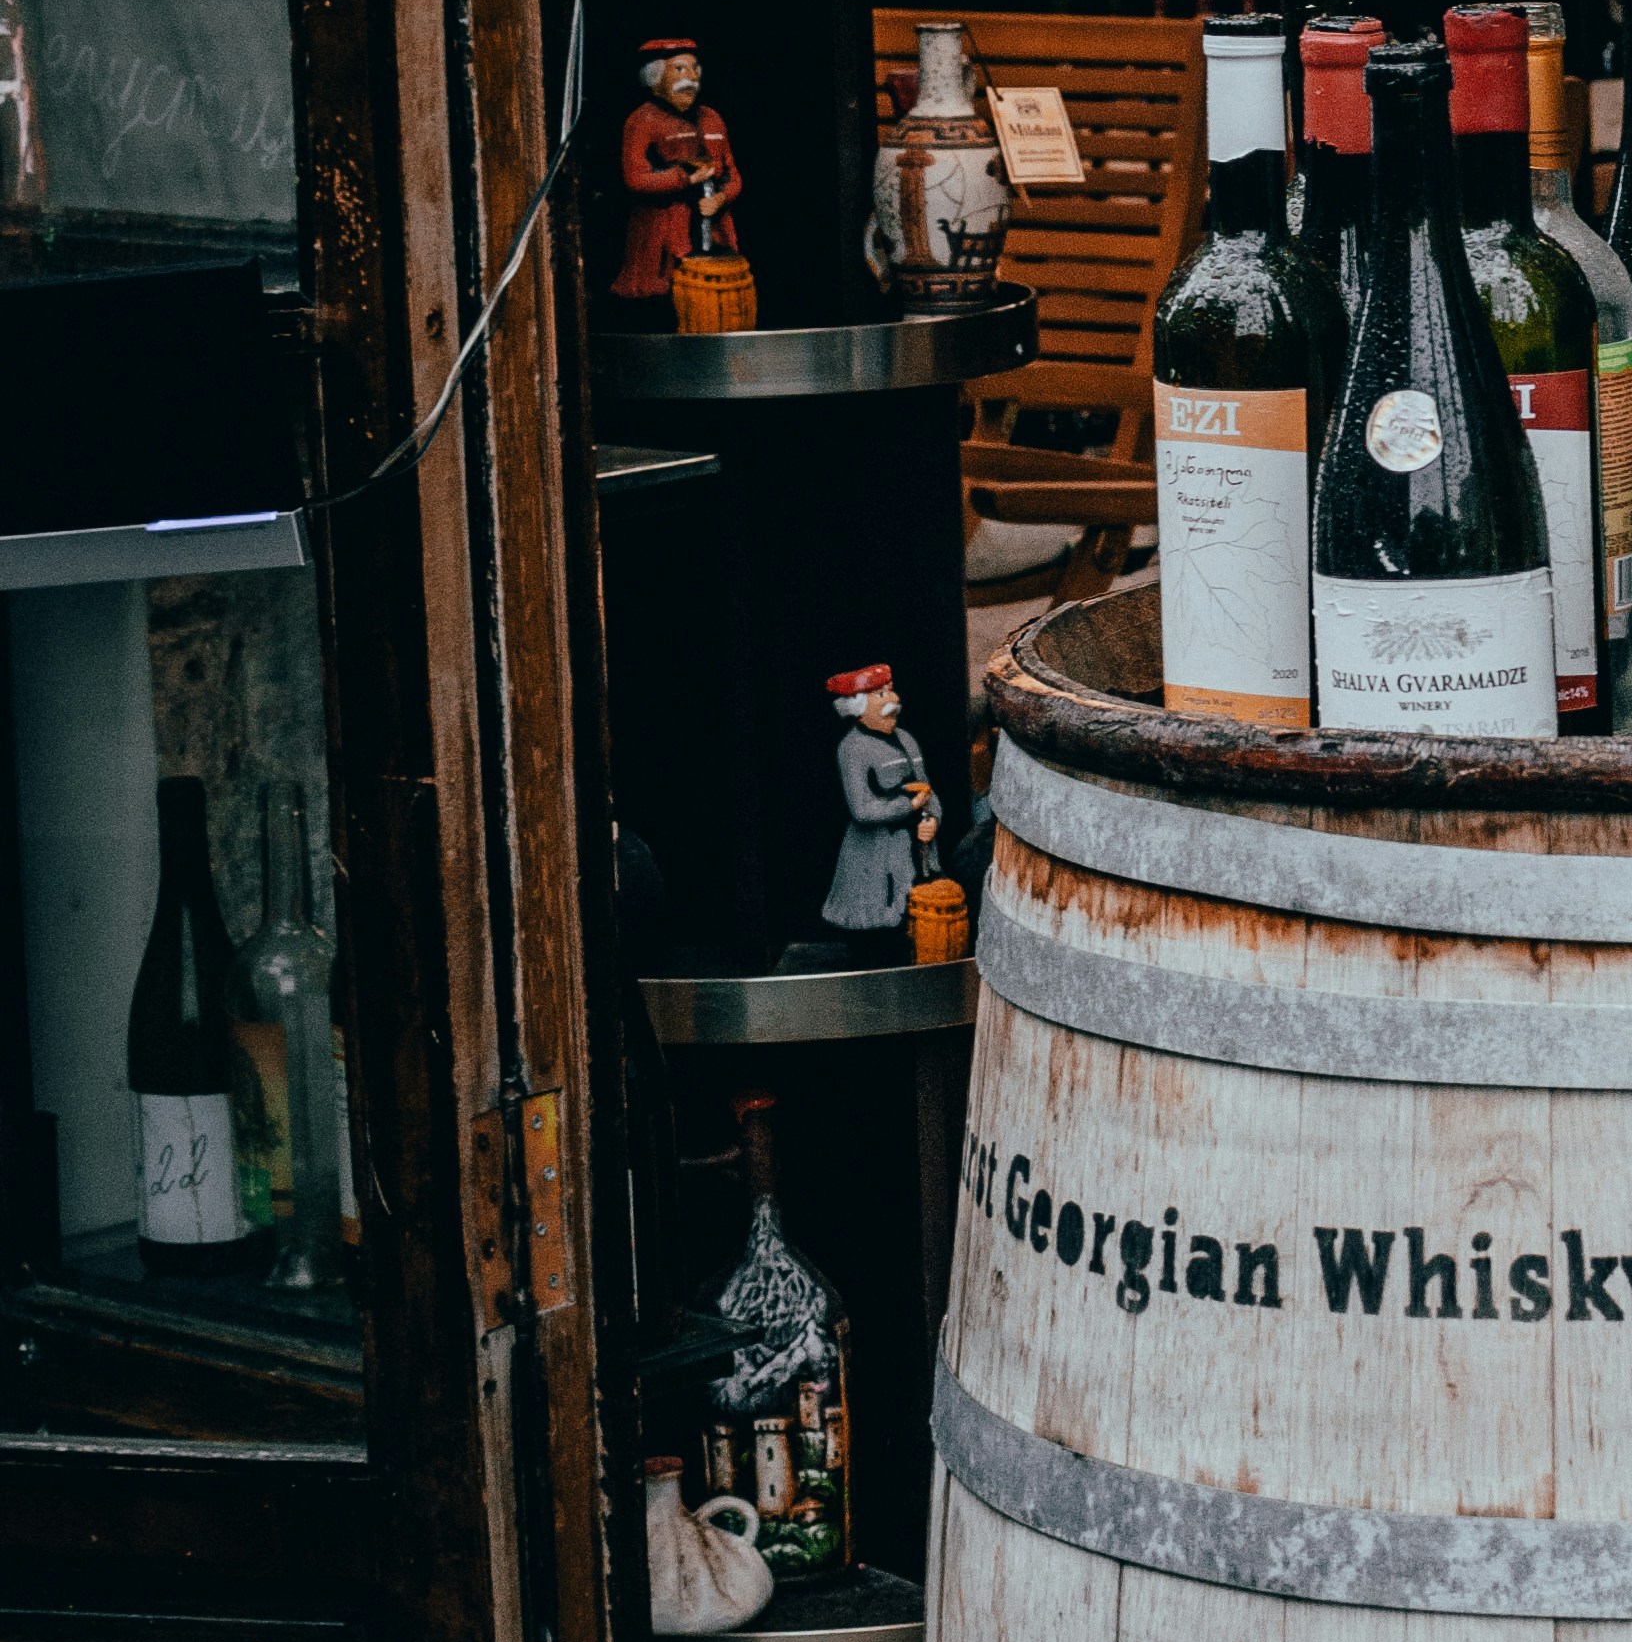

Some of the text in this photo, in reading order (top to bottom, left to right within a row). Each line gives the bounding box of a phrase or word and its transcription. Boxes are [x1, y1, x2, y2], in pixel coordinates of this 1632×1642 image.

[1169, 396, 1242, 437] EZI
[1271, 668, 1299, 680] 2020
[1331, 665, 1528, 694] SHALVA GVARAMADZE
[1397, 699, 1453, 712] WINERY
[1004, 1153, 1284, 1314] Georgian
